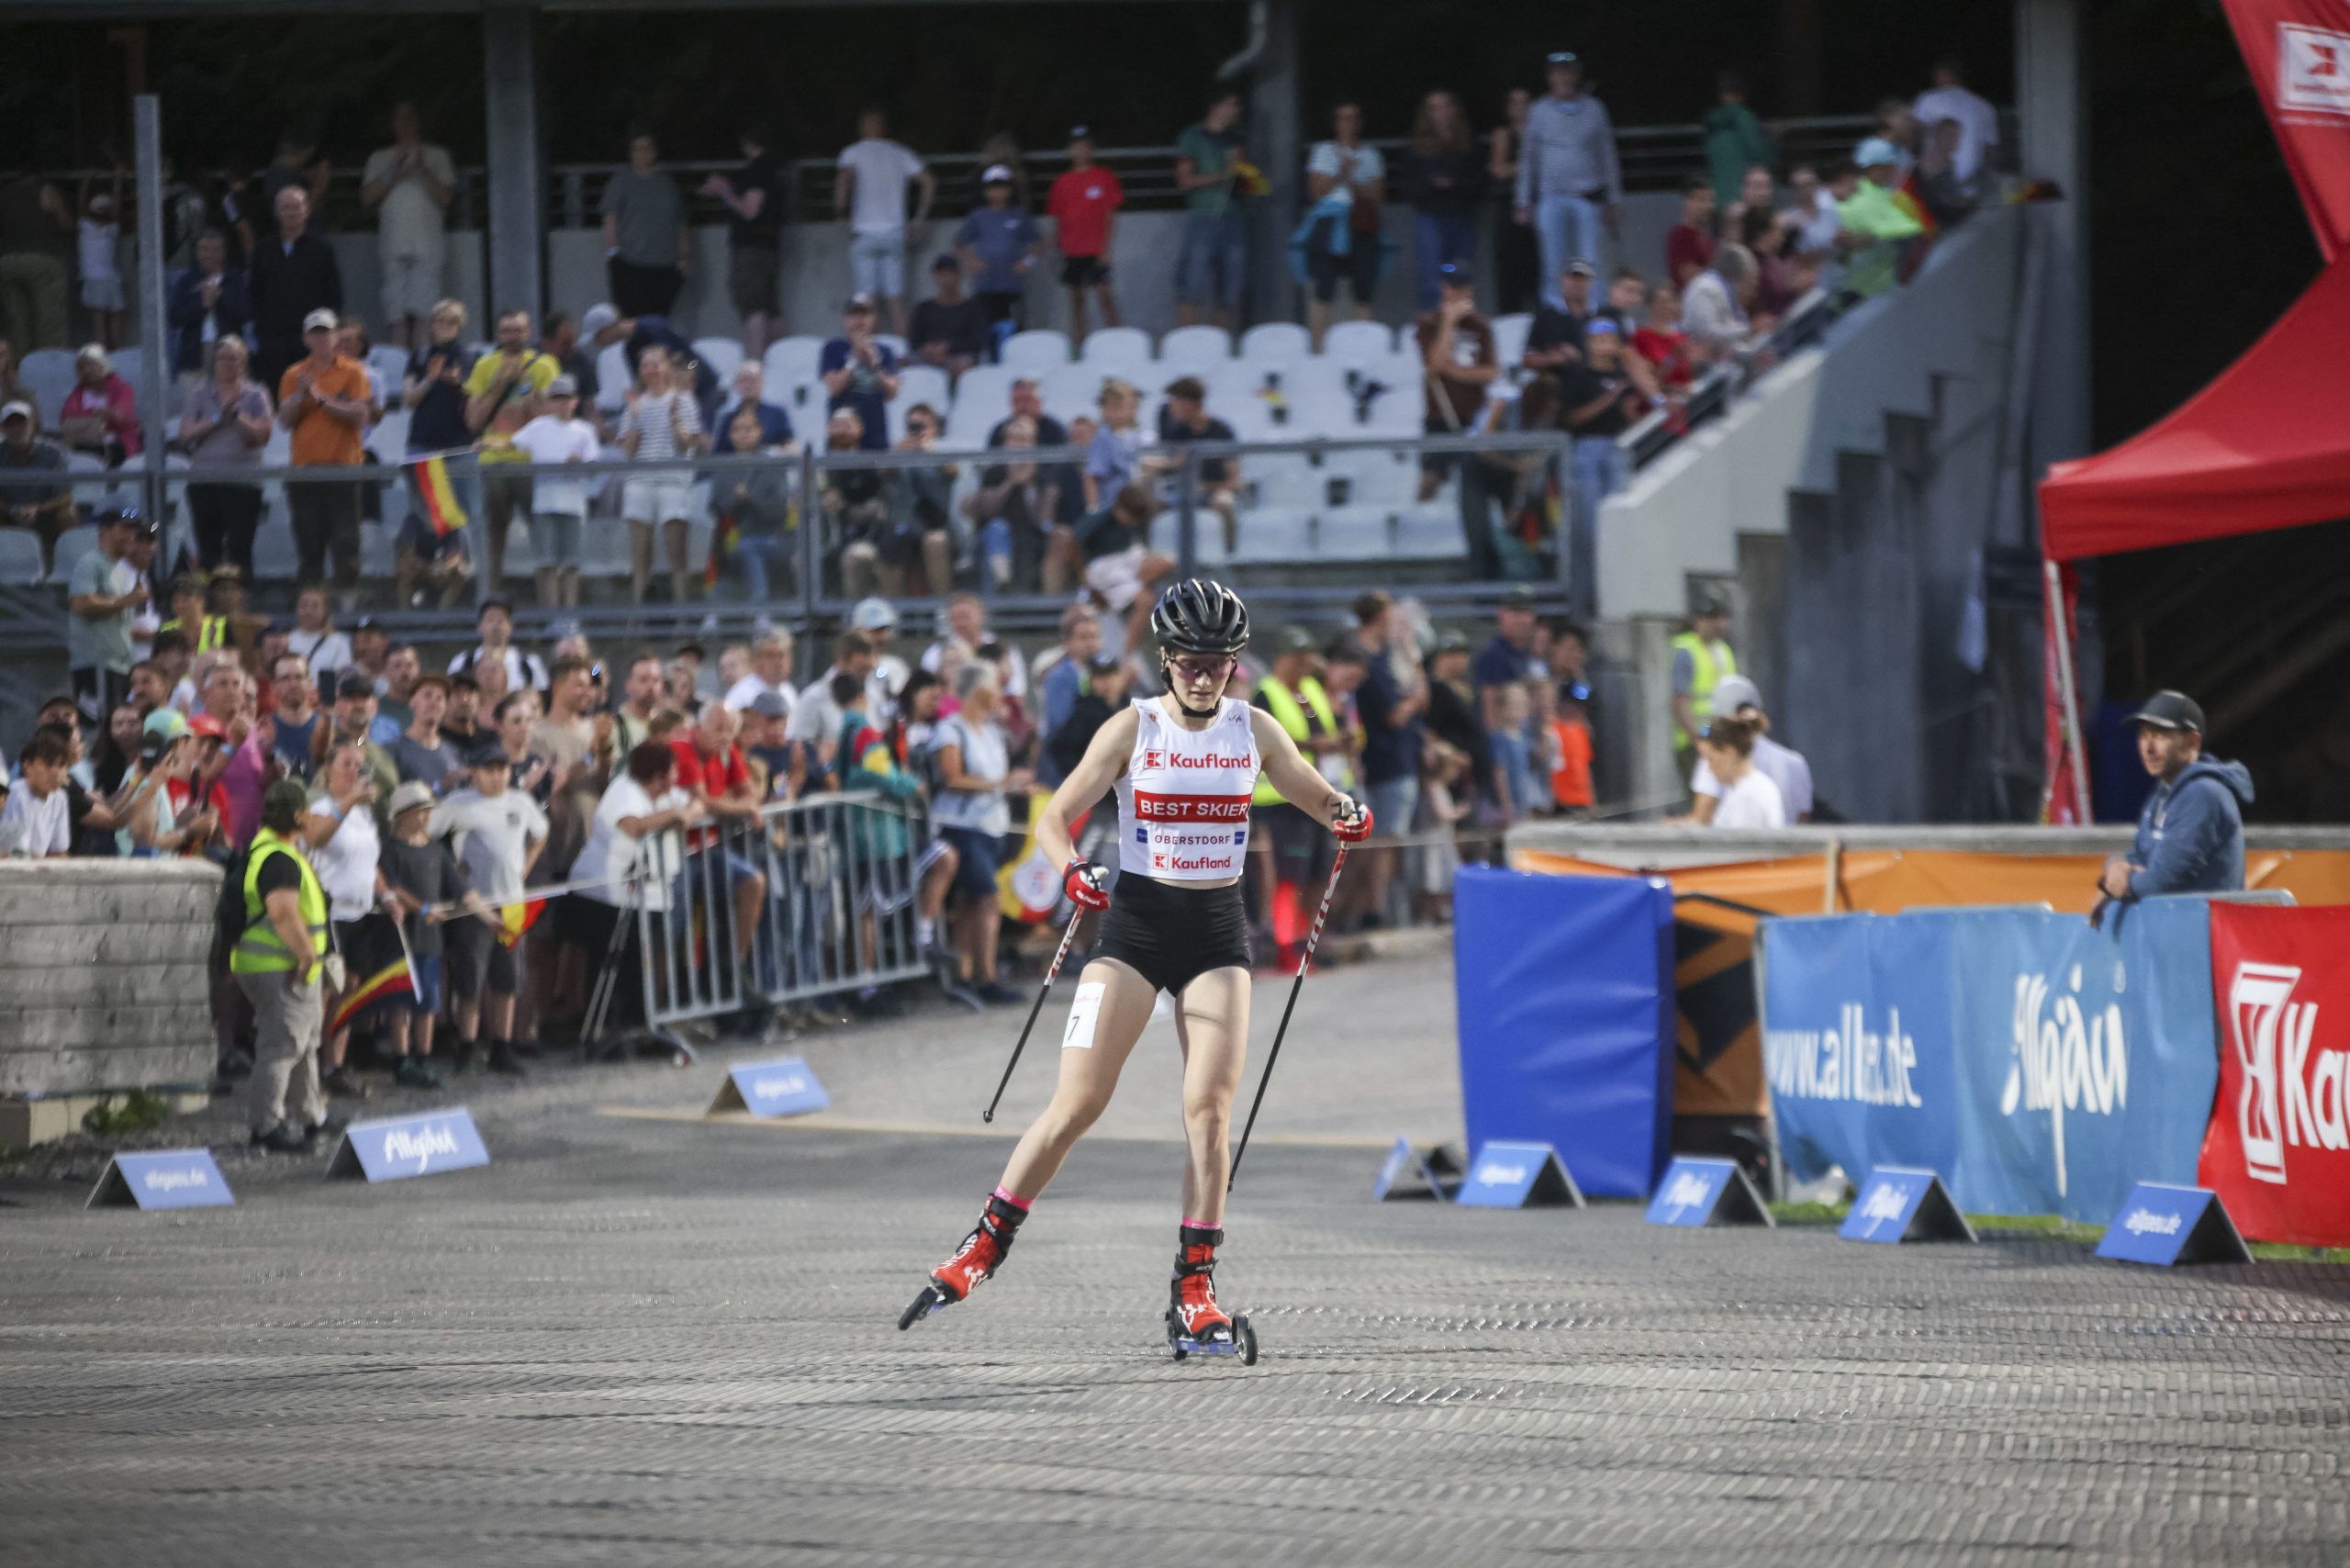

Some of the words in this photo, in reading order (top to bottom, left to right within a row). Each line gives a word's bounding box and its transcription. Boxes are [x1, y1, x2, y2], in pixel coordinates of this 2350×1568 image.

[1170, 753, 1251, 769] Kaufland
[1140, 800, 1193, 815] BEST
[1196, 801, 1247, 817] SKIER
[1154, 834, 1231, 846] OBERSTDORF
[1171, 856, 1231, 869] Kaufland
[1068, 1015, 1080, 1041] 7
[2282, 1002, 2350, 1151] Ka
